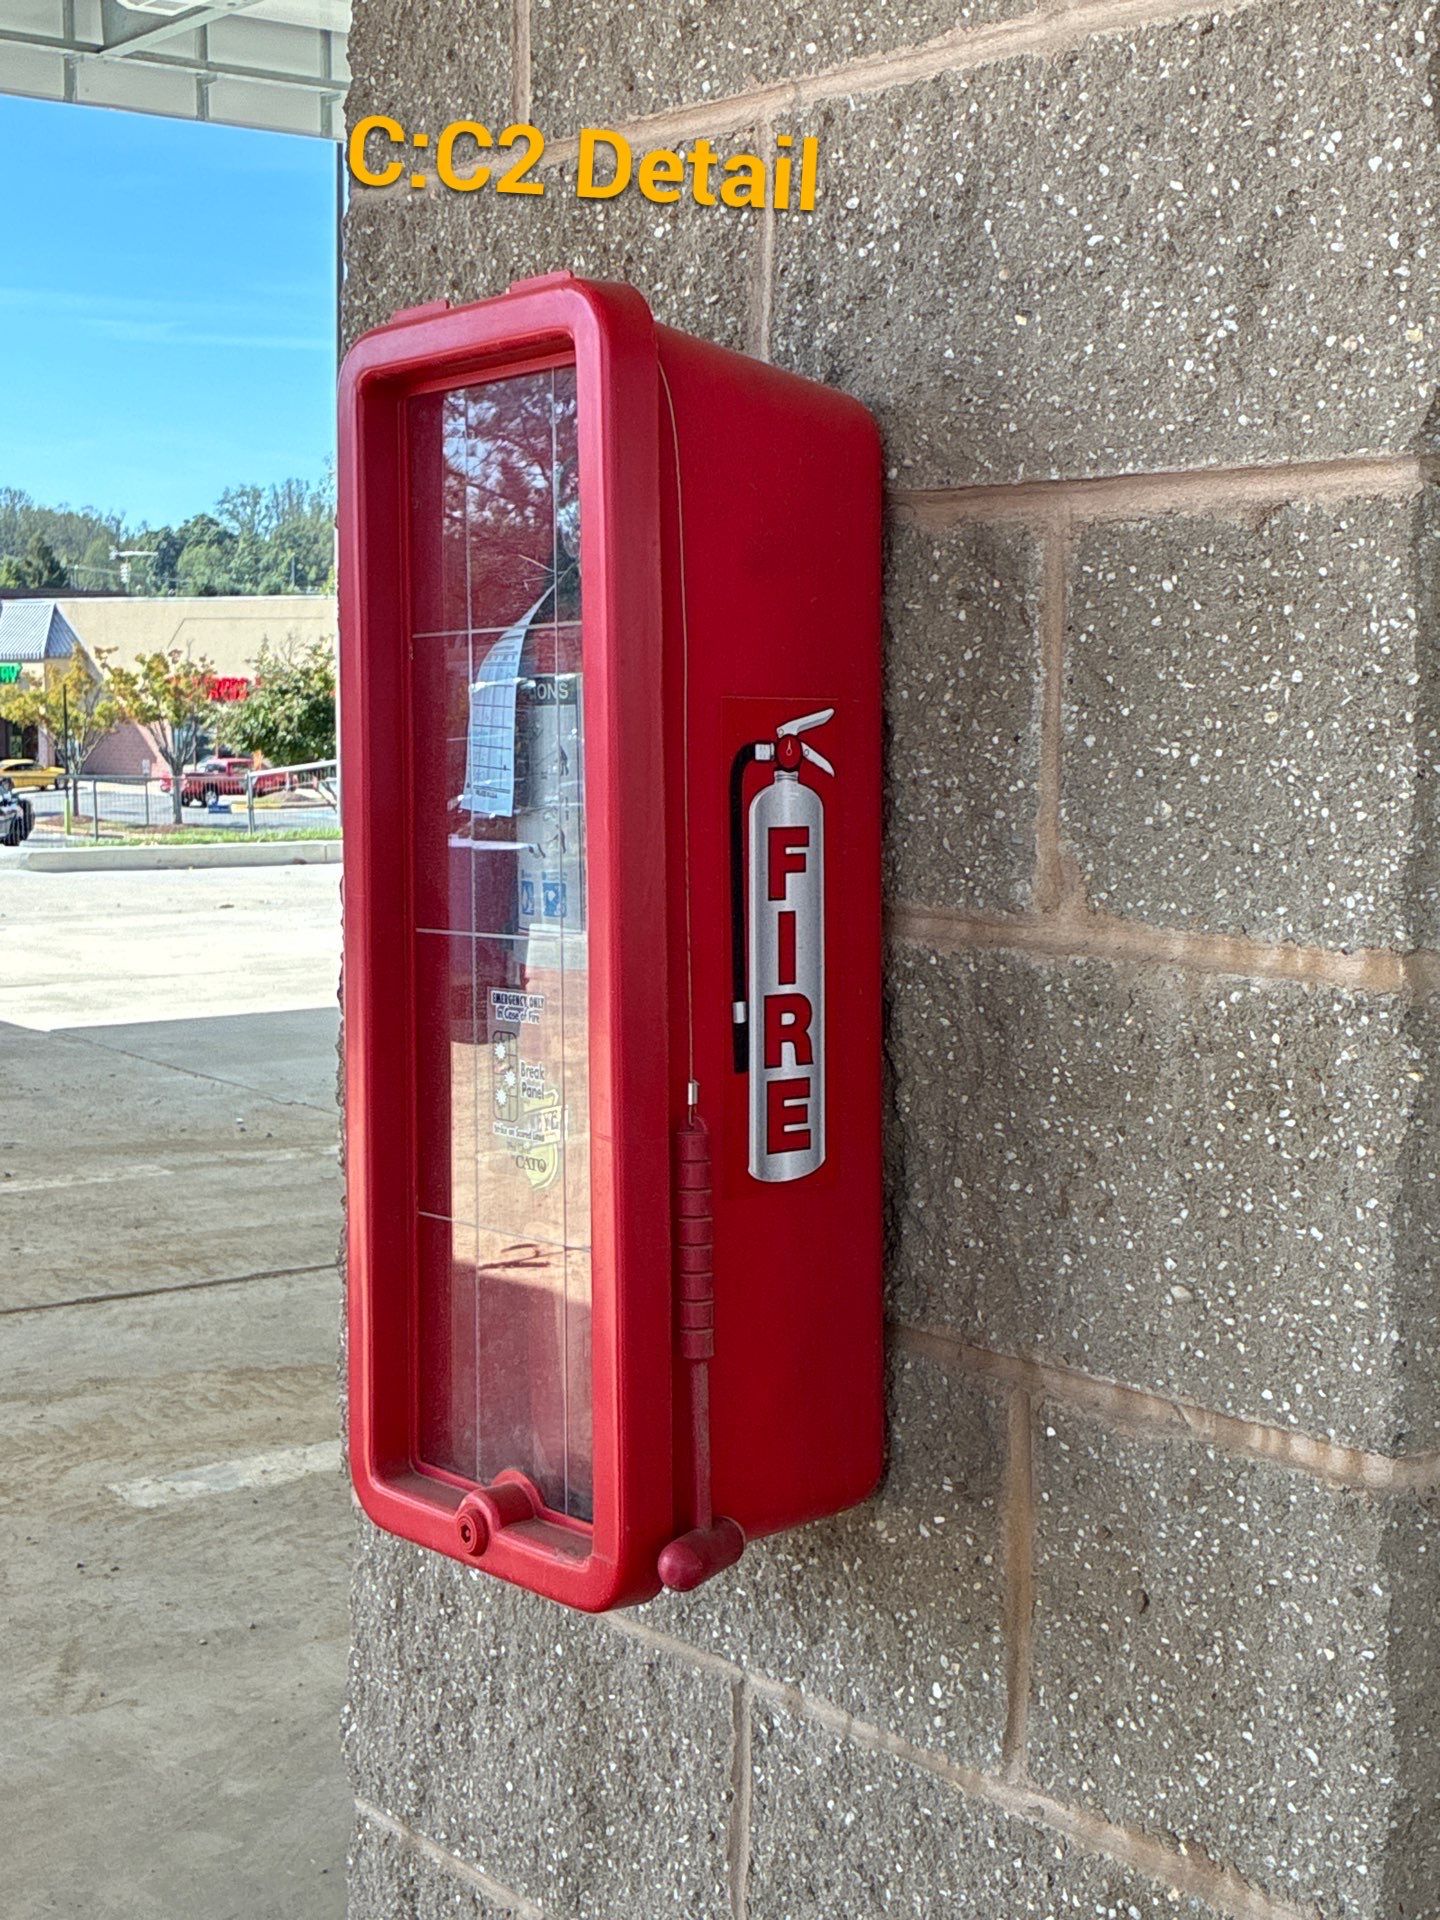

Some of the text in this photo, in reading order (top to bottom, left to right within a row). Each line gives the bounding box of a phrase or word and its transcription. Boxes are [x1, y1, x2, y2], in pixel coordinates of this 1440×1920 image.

[763, 825, 815, 1156] FIRE
[493, 992, 544, 1008] EMERGENCY ONLY
[504, 1007, 520, 1020] Case
[529, 1010, 540, 1024] Fire
[521, 1062, 545, 1080] Break
[522, 1082, 545, 1100] Panel
[516, 1155, 547, 1173] CATO
